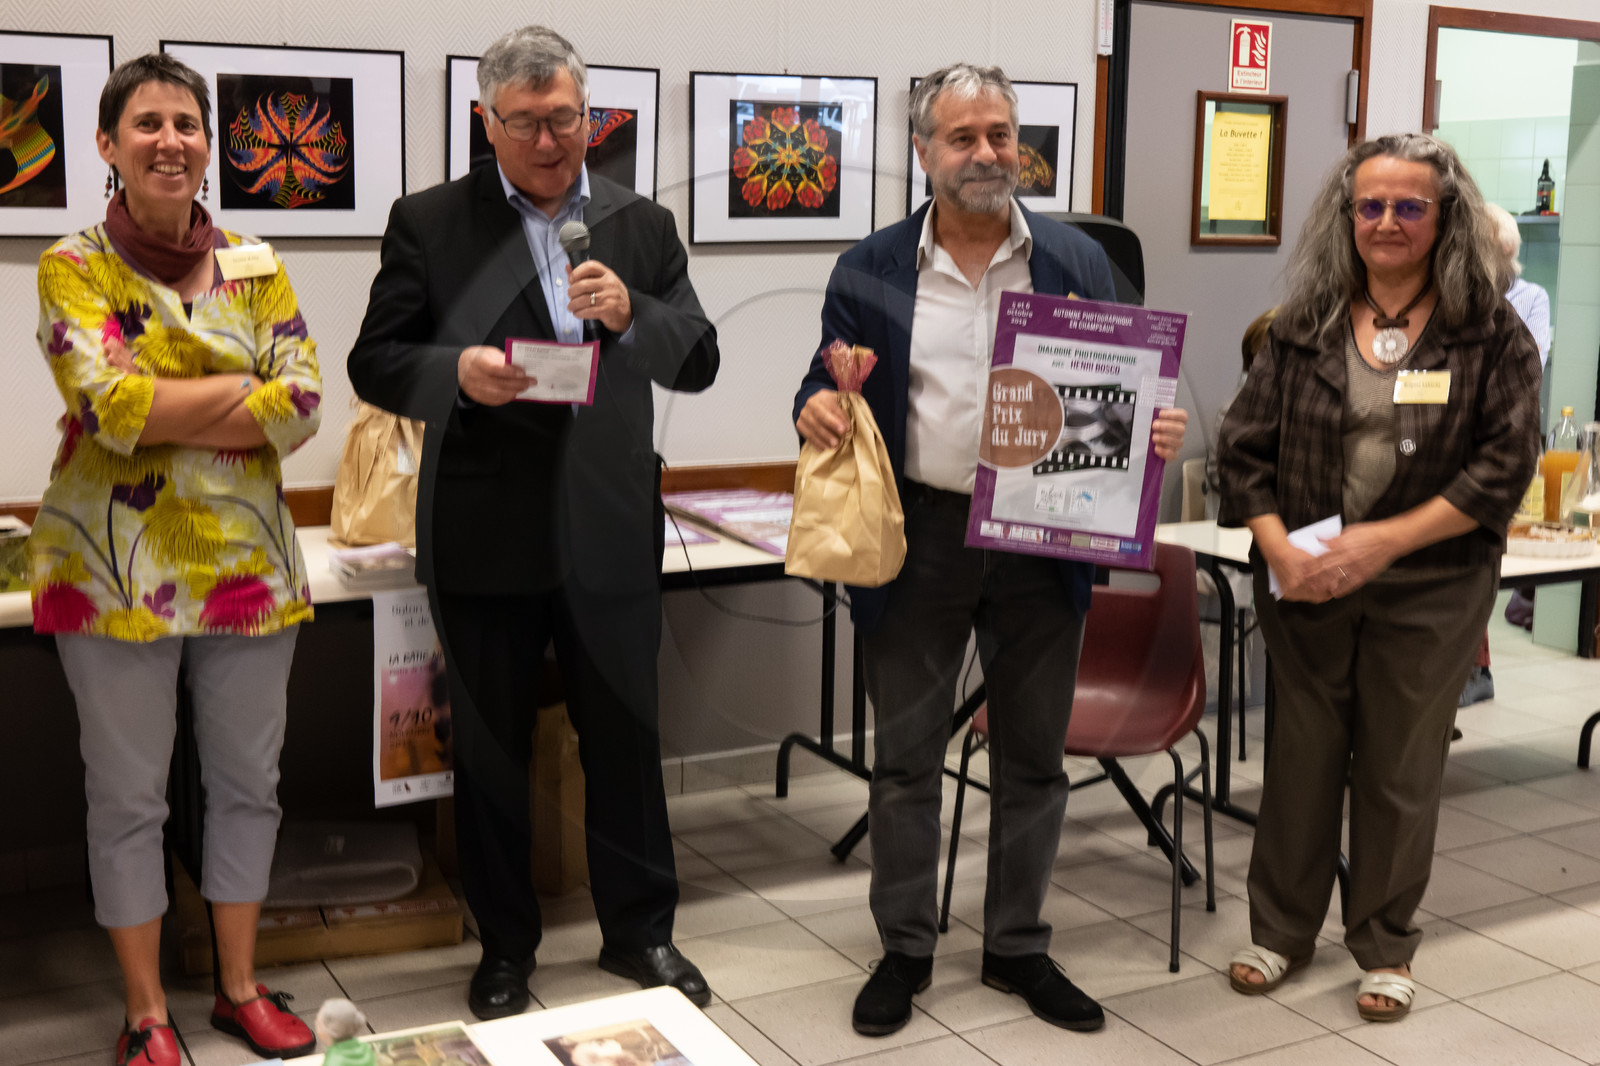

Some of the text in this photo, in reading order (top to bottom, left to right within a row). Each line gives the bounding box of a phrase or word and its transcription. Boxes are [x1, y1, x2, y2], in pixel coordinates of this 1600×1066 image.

[1219, 129, 1229, 138] La
[1230, 130, 1258, 139] Buvette
[1053, 307, 1081, 321] AUTOMNE
[1082, 310, 1133, 327] PHOTOGRAPHIQUE
[1069, 320, 1078, 329] EN
[1037, 344, 1137, 366] DIALOGUE PHOTOGRAPHIQUE
[1070, 359, 1093, 372] HENRI
[1094, 363, 1120, 376] BOSCO
[992, 380, 1033, 403] Grand
[992, 404, 1022, 425] Prix
[992, 426, 1048, 449] du Jury
[389, 652, 399, 665] LA
